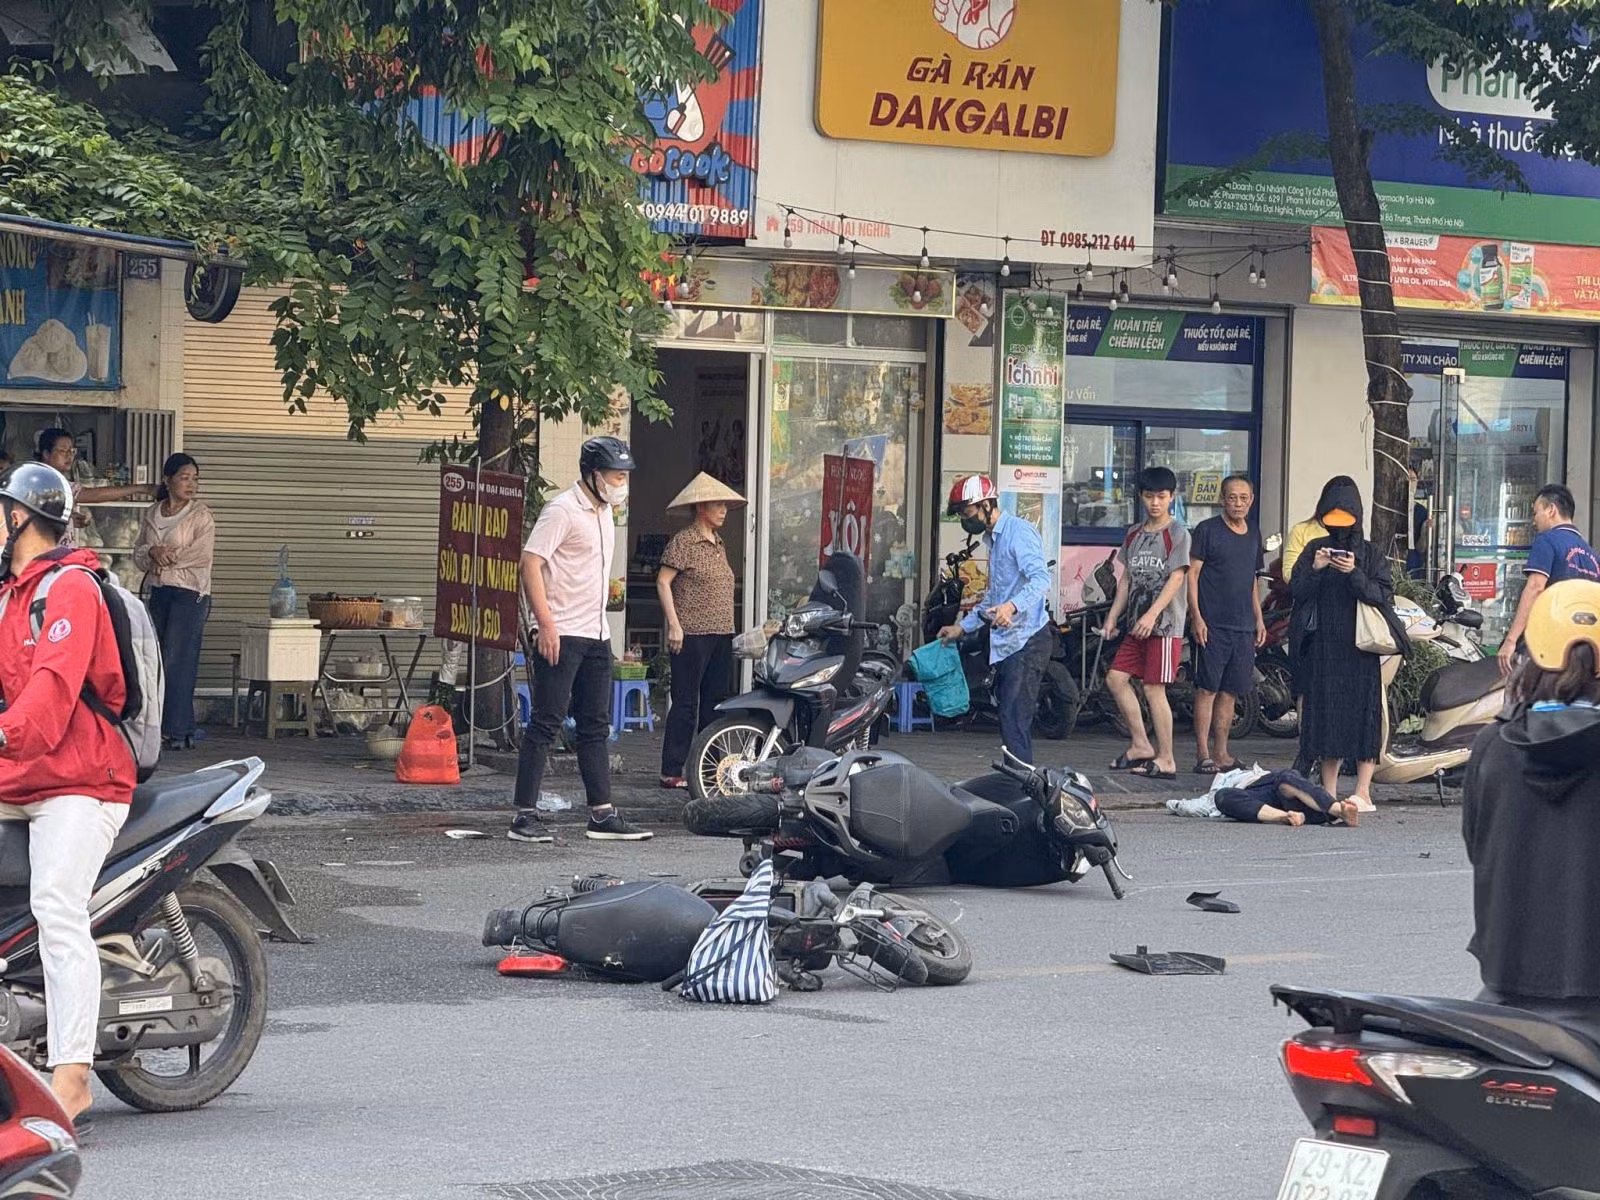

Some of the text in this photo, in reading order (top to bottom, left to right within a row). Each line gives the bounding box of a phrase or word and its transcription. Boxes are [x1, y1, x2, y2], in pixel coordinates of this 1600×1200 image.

[906, 53, 1036, 91] GÀ RÁN
[869, 92, 1069, 140] DAKGALBI
[645, 203, 684, 220] 0944
[689, 206, 704, 222] 01
[710, 207, 748, 225] 9889
[1041, 229, 1056, 247] ĐT
[1113, 235, 1135, 252] 644
[1400, 236, 1428, 247] BRAUER
[129, 258, 157, 276] 255
[1113, 315, 1163, 333] HOÀN TIỀN
[1184, 324, 1209, 338] THUỐC
[1109, 334, 1165, 353] CHÊNH LỆCH
[1416, 354, 1431, 365] XIN
[1432, 353, 1457, 367] CHÀO
[1519, 352, 1565, 368] CHÊNH LỆCH
[445, 475, 463, 489] 255
[467, 480, 485, 493] TRN
[486, 484, 498, 496] ĐẠI
[485, 506, 509, 539] BAO
[483, 603, 501, 641] GIÒ
[1486, 1095, 1528, 1108] BLACK
